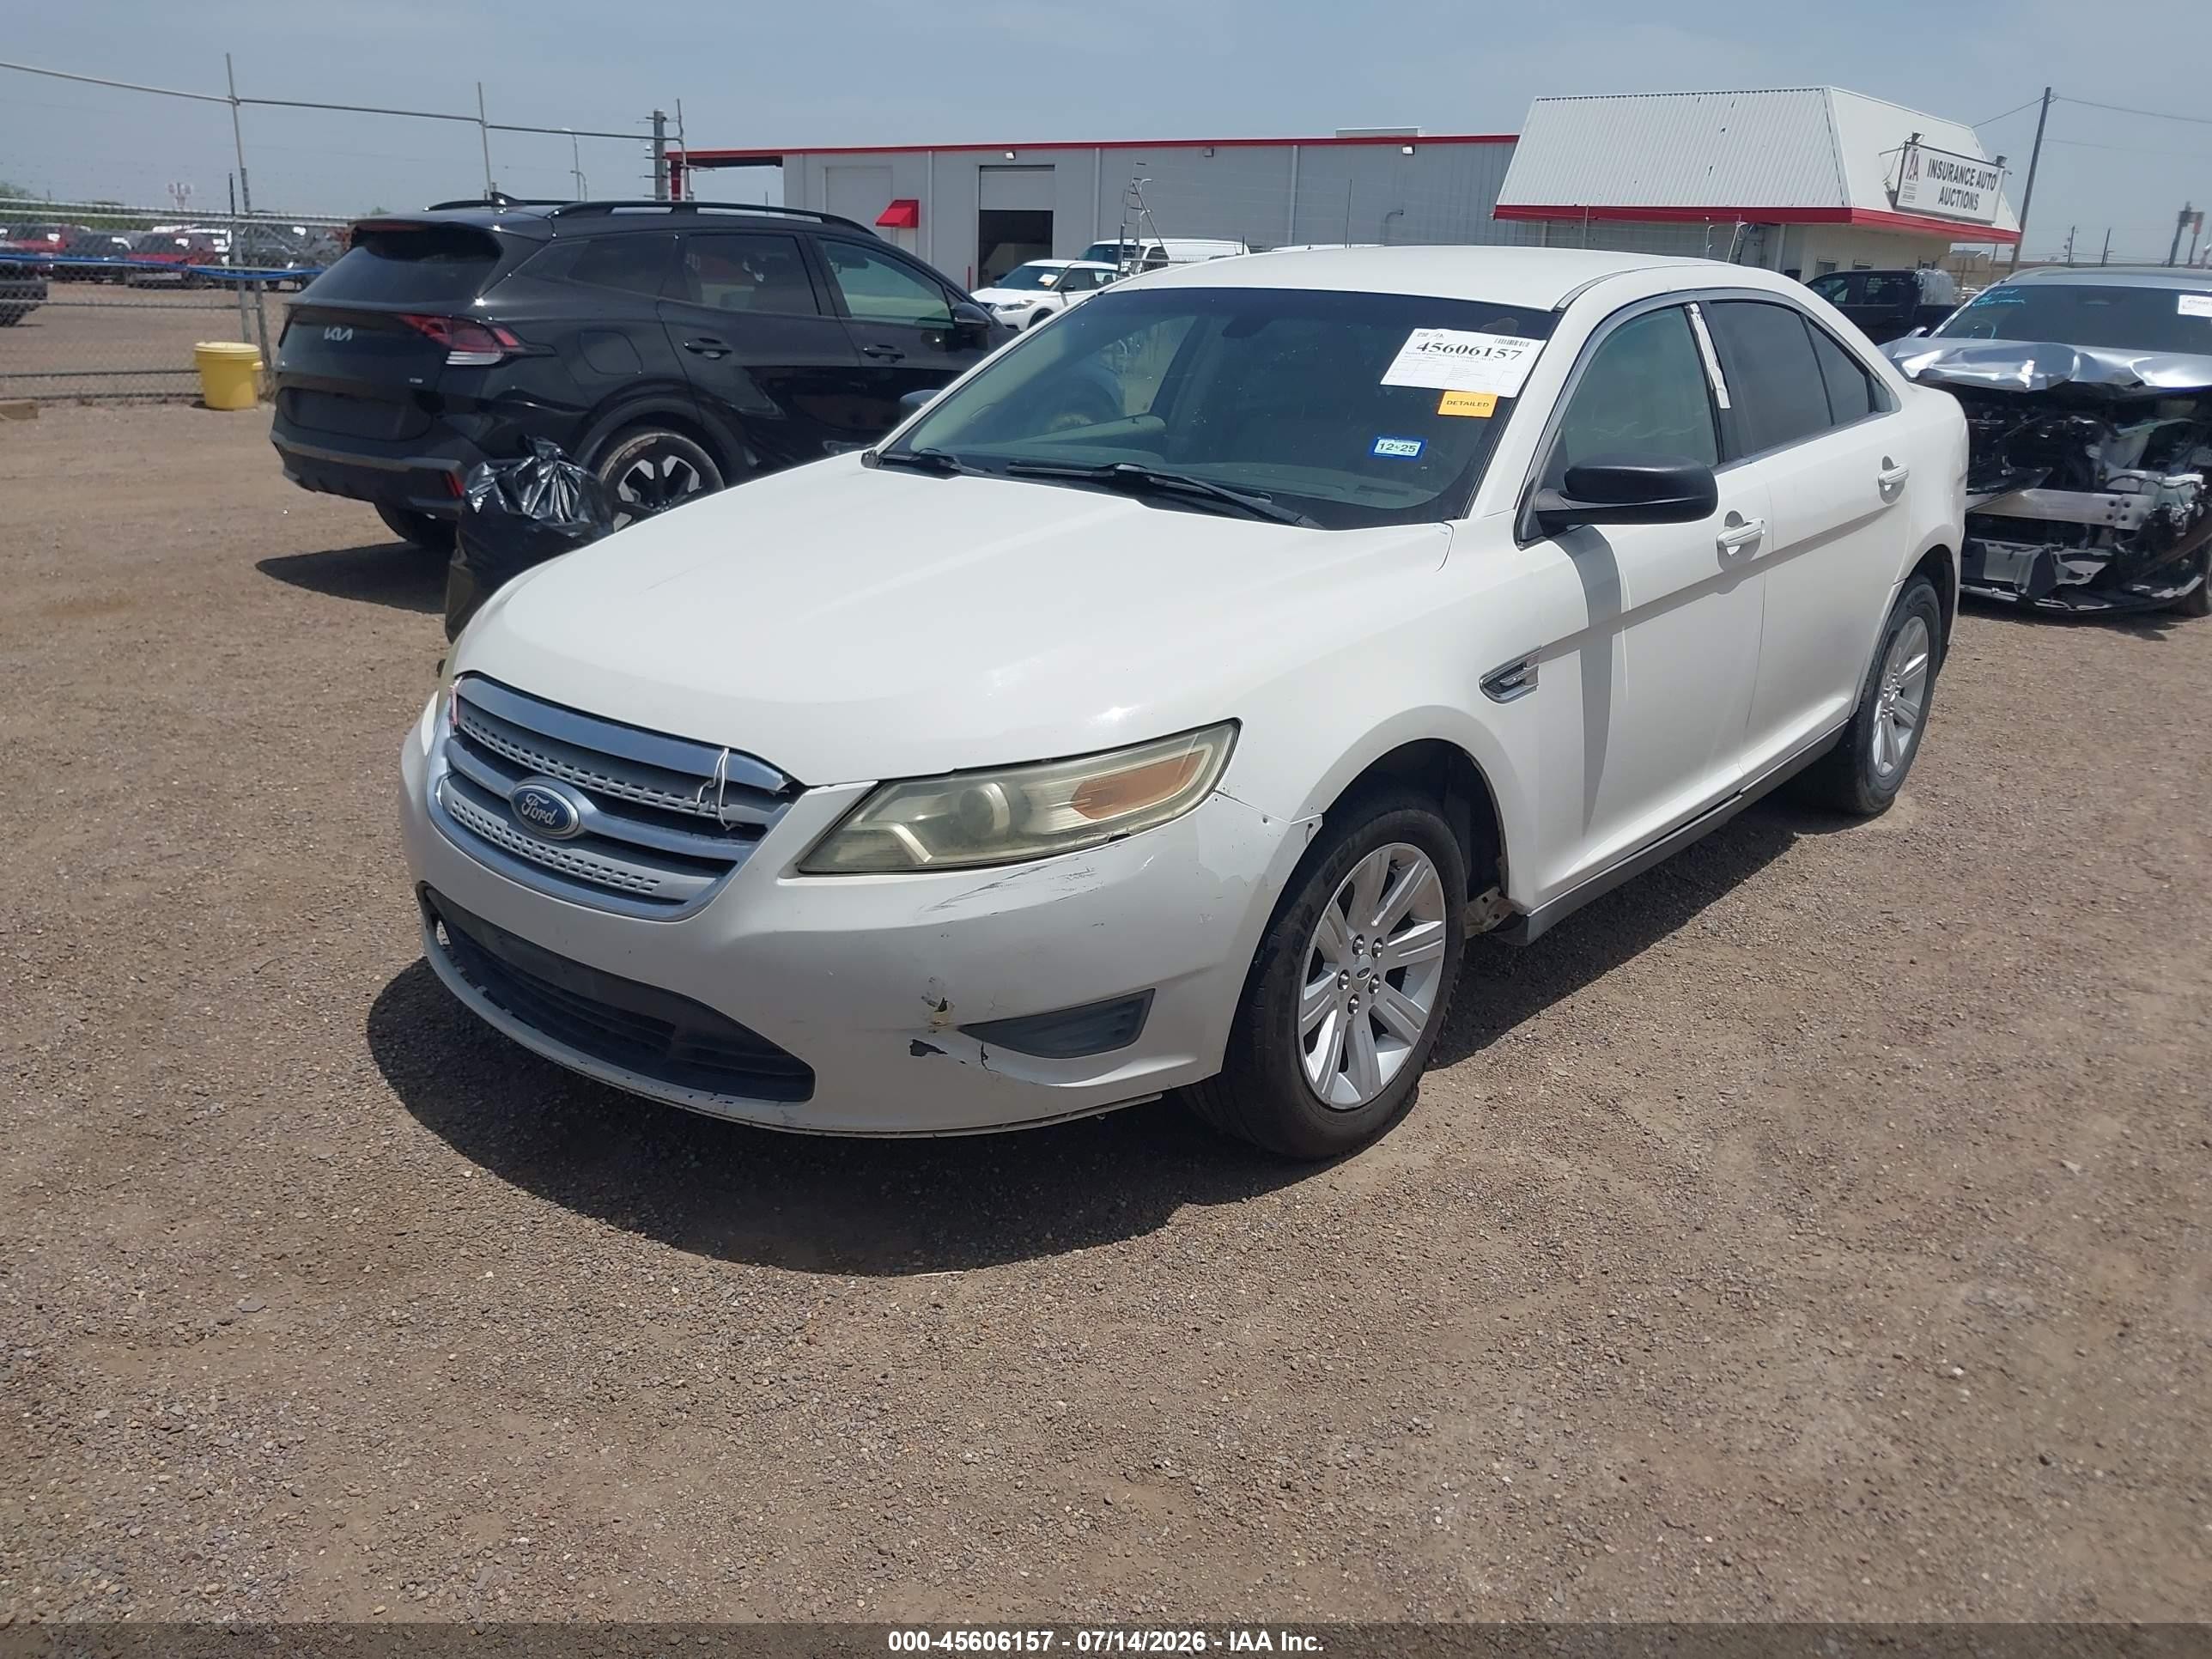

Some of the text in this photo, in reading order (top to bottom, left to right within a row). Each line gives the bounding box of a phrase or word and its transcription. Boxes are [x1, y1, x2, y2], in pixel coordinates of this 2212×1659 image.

[1927, 158, 1997, 191] INSURANCE AUTO
[1937, 186, 1979, 211] AUCTIONS
[1416, 342, 1523, 361] 45606157
[1446, 399, 1490, 408] DETAILED
[521, 793, 558, 825] Ford
